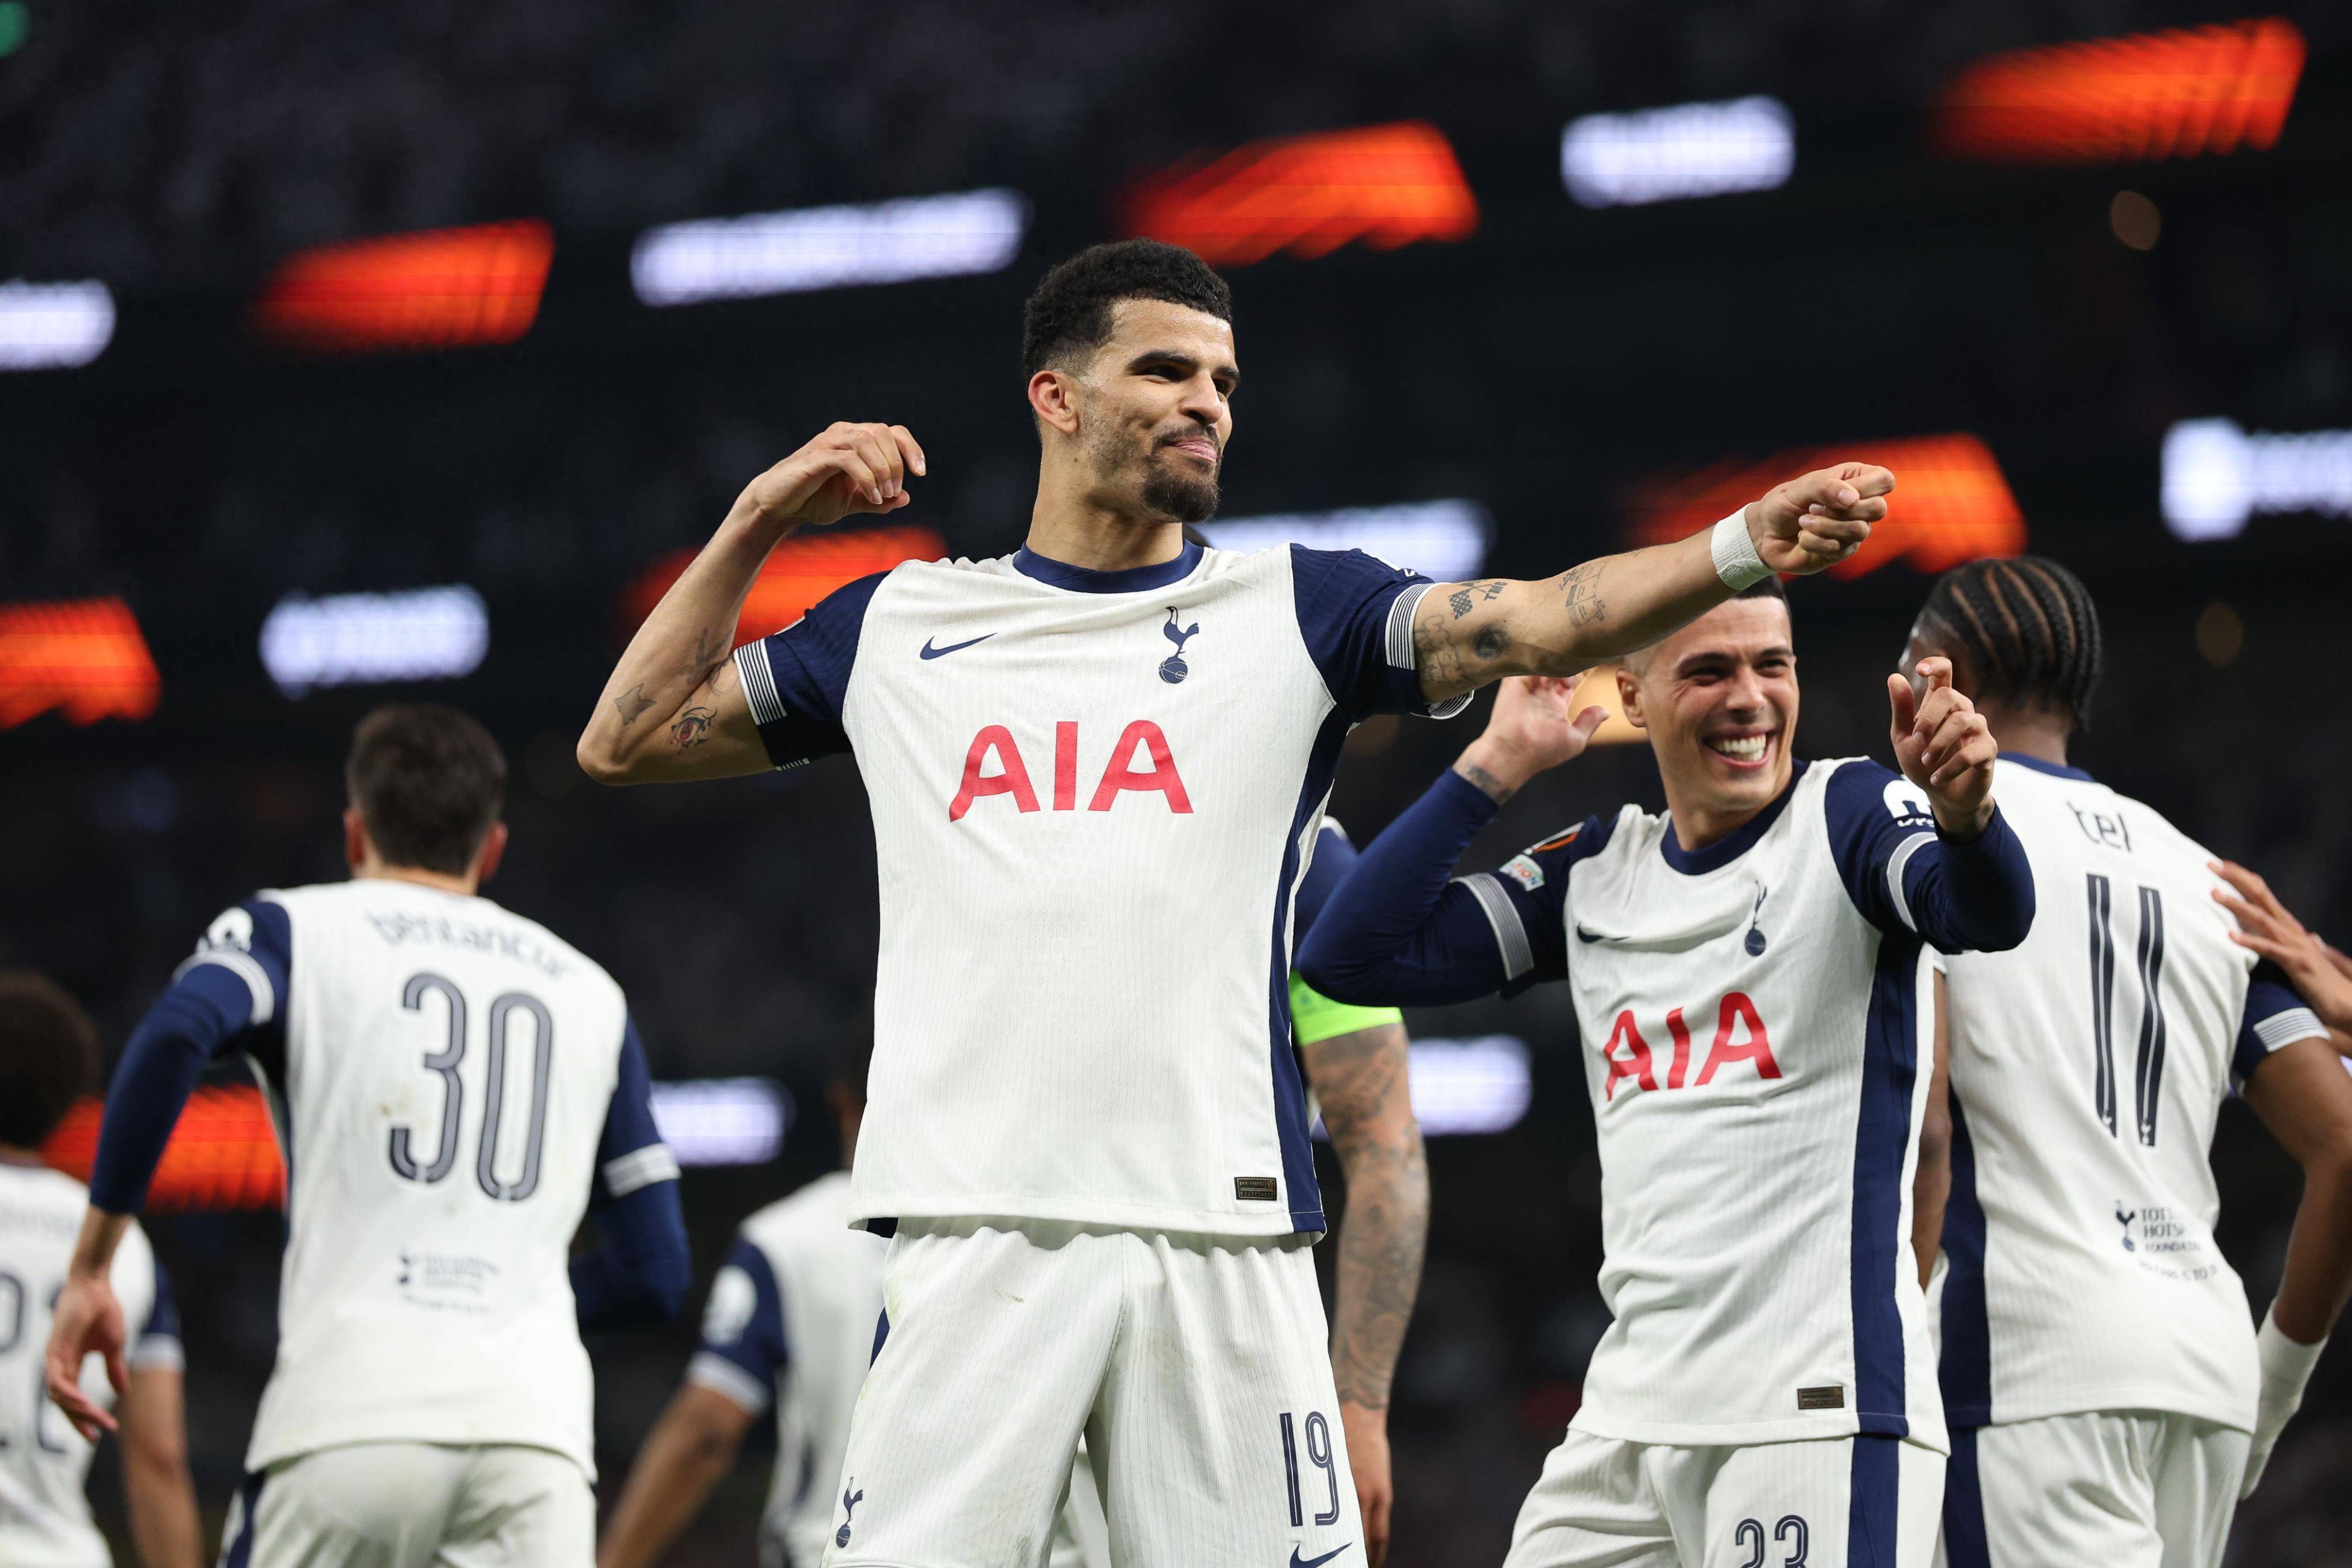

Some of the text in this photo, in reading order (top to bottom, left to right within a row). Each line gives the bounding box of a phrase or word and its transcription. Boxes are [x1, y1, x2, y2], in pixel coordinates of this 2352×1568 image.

[950, 720, 1193, 822] AIA
[2066, 801, 2131, 852] tel
[1604, 992, 1783, 1101] AIA
[2086, 873, 2166, 1148] 11
[389, 973, 552, 1201] 30
[1280, 1411, 1339, 1526] 19
